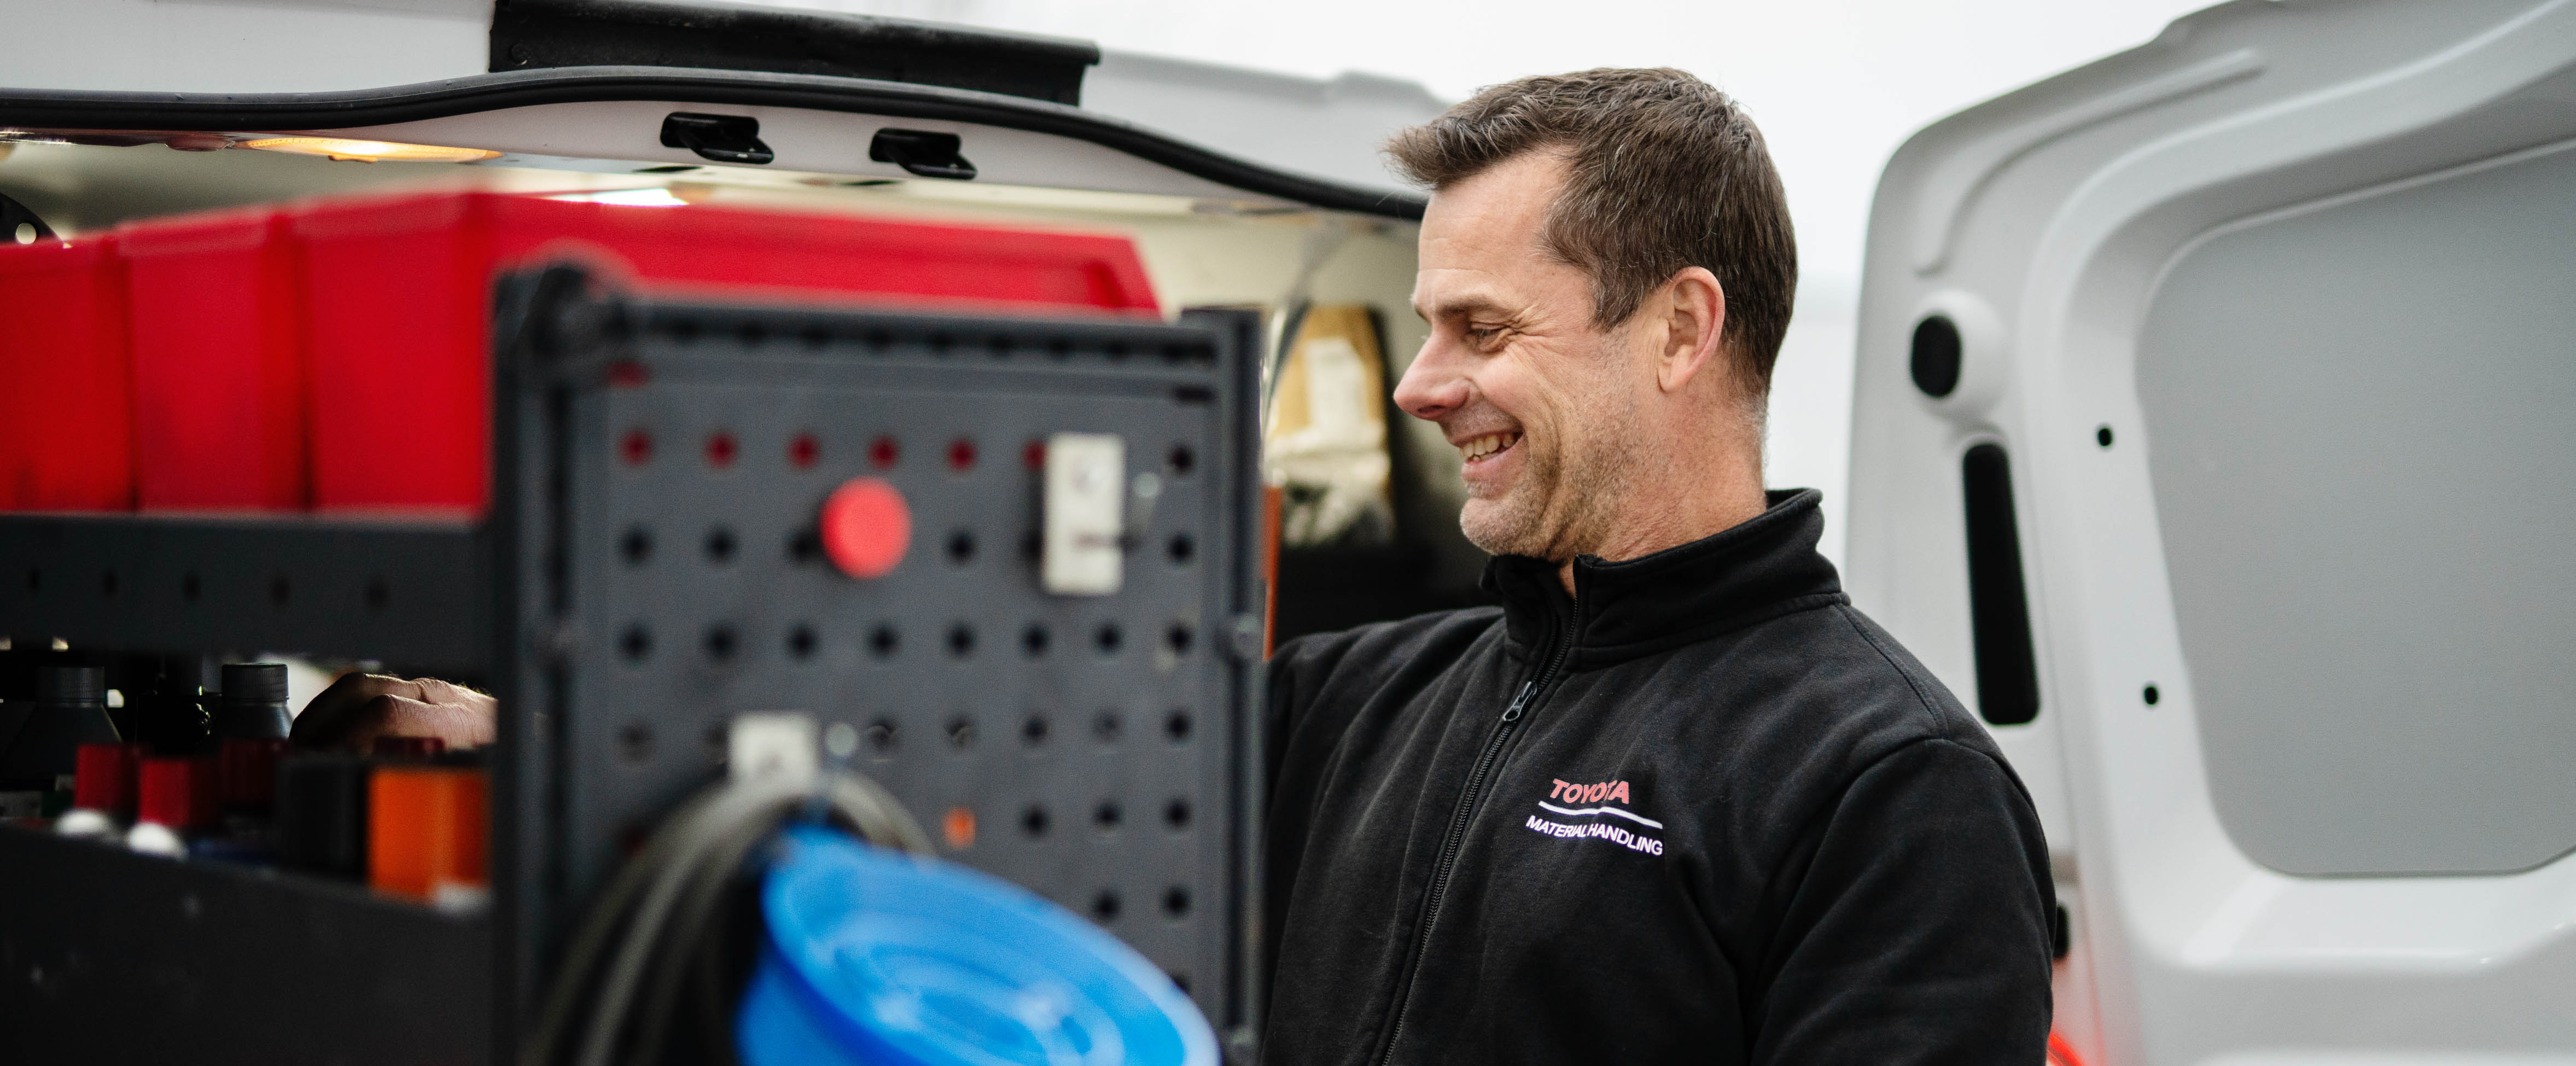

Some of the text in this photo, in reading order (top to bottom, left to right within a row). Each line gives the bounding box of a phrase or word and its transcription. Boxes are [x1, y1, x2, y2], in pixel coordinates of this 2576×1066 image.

[1550, 778, 1629, 804] TOYOTA
[1526, 815, 1663, 856] MATERIAL HANDLING
